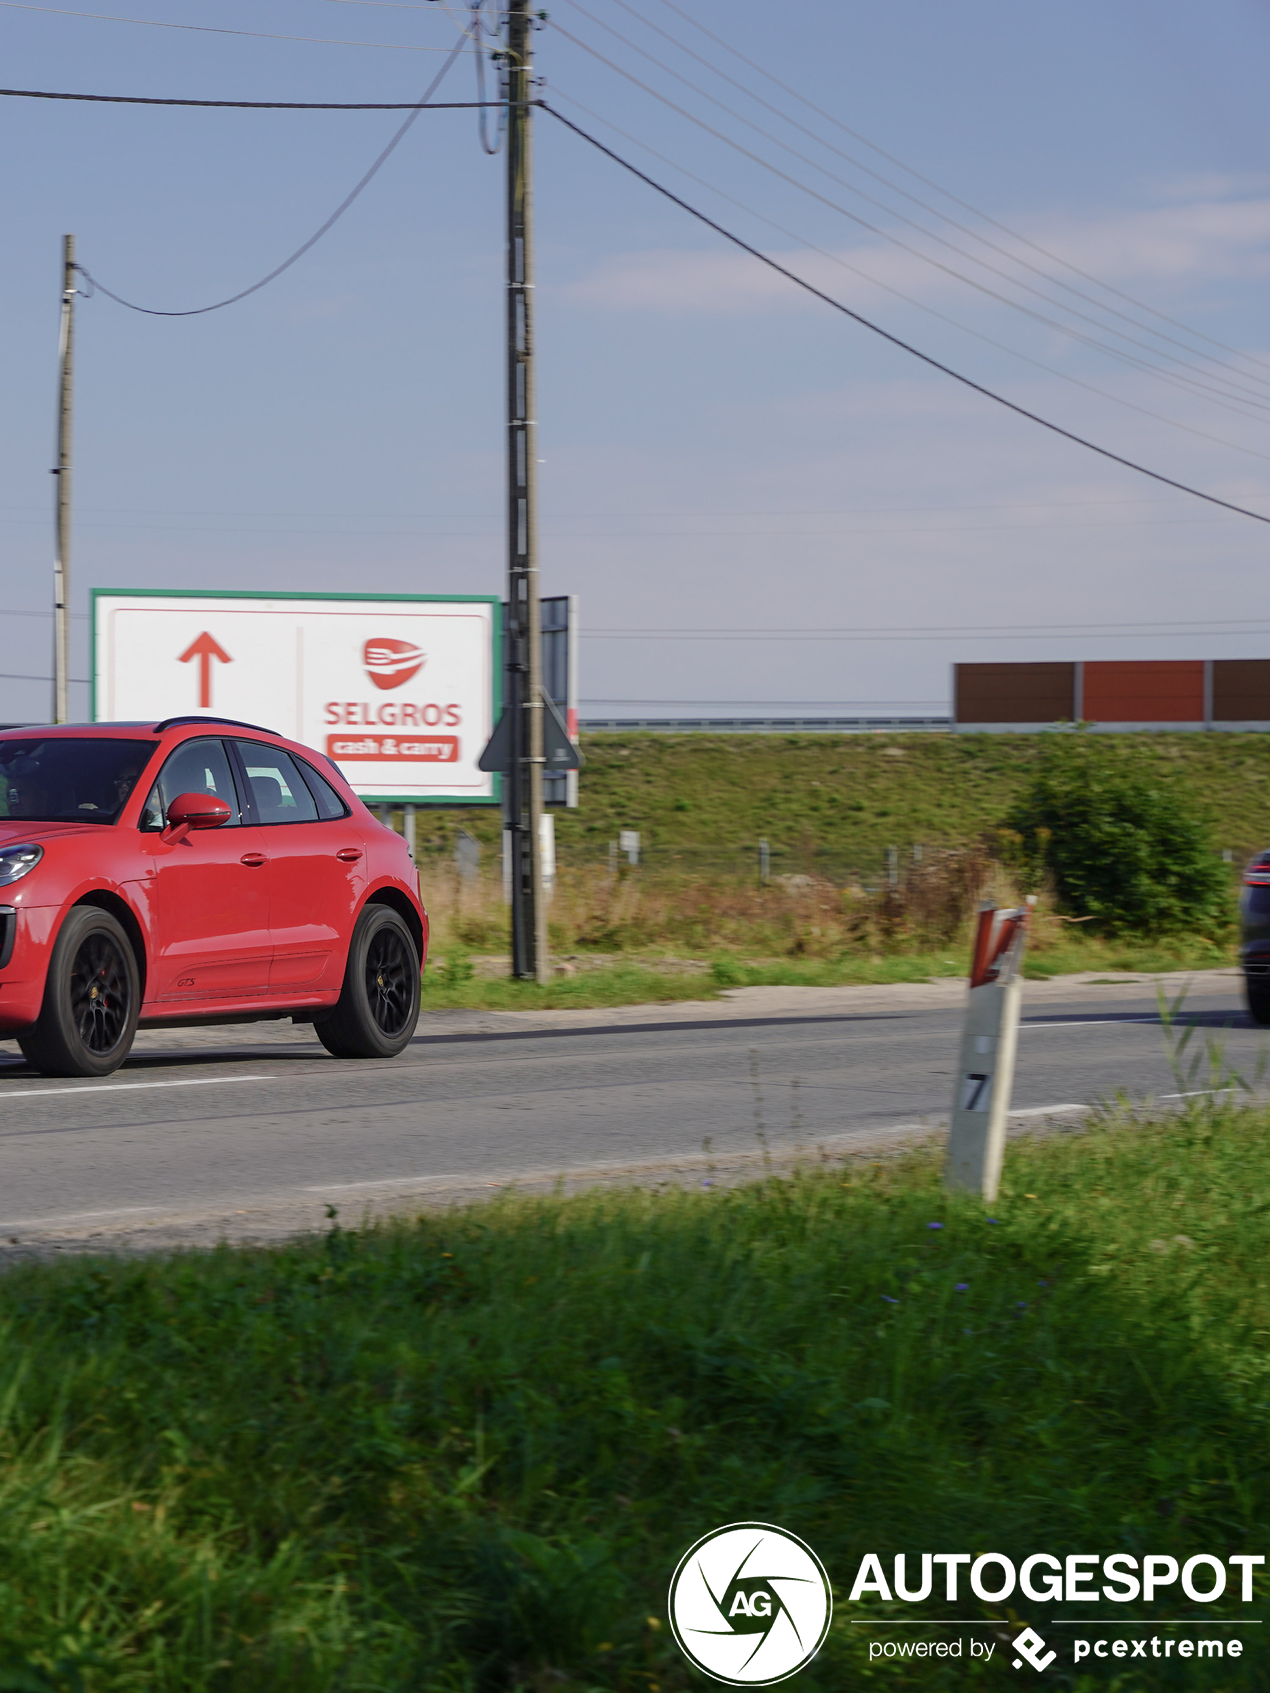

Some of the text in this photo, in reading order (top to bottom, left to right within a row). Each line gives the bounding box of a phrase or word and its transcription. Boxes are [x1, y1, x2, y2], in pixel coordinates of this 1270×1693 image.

[324, 702, 462, 727] SELGROS
[332, 738, 454, 760] cash & carry
[177, 977, 196, 987] GTS
[964, 1073, 991, 1110] 7
